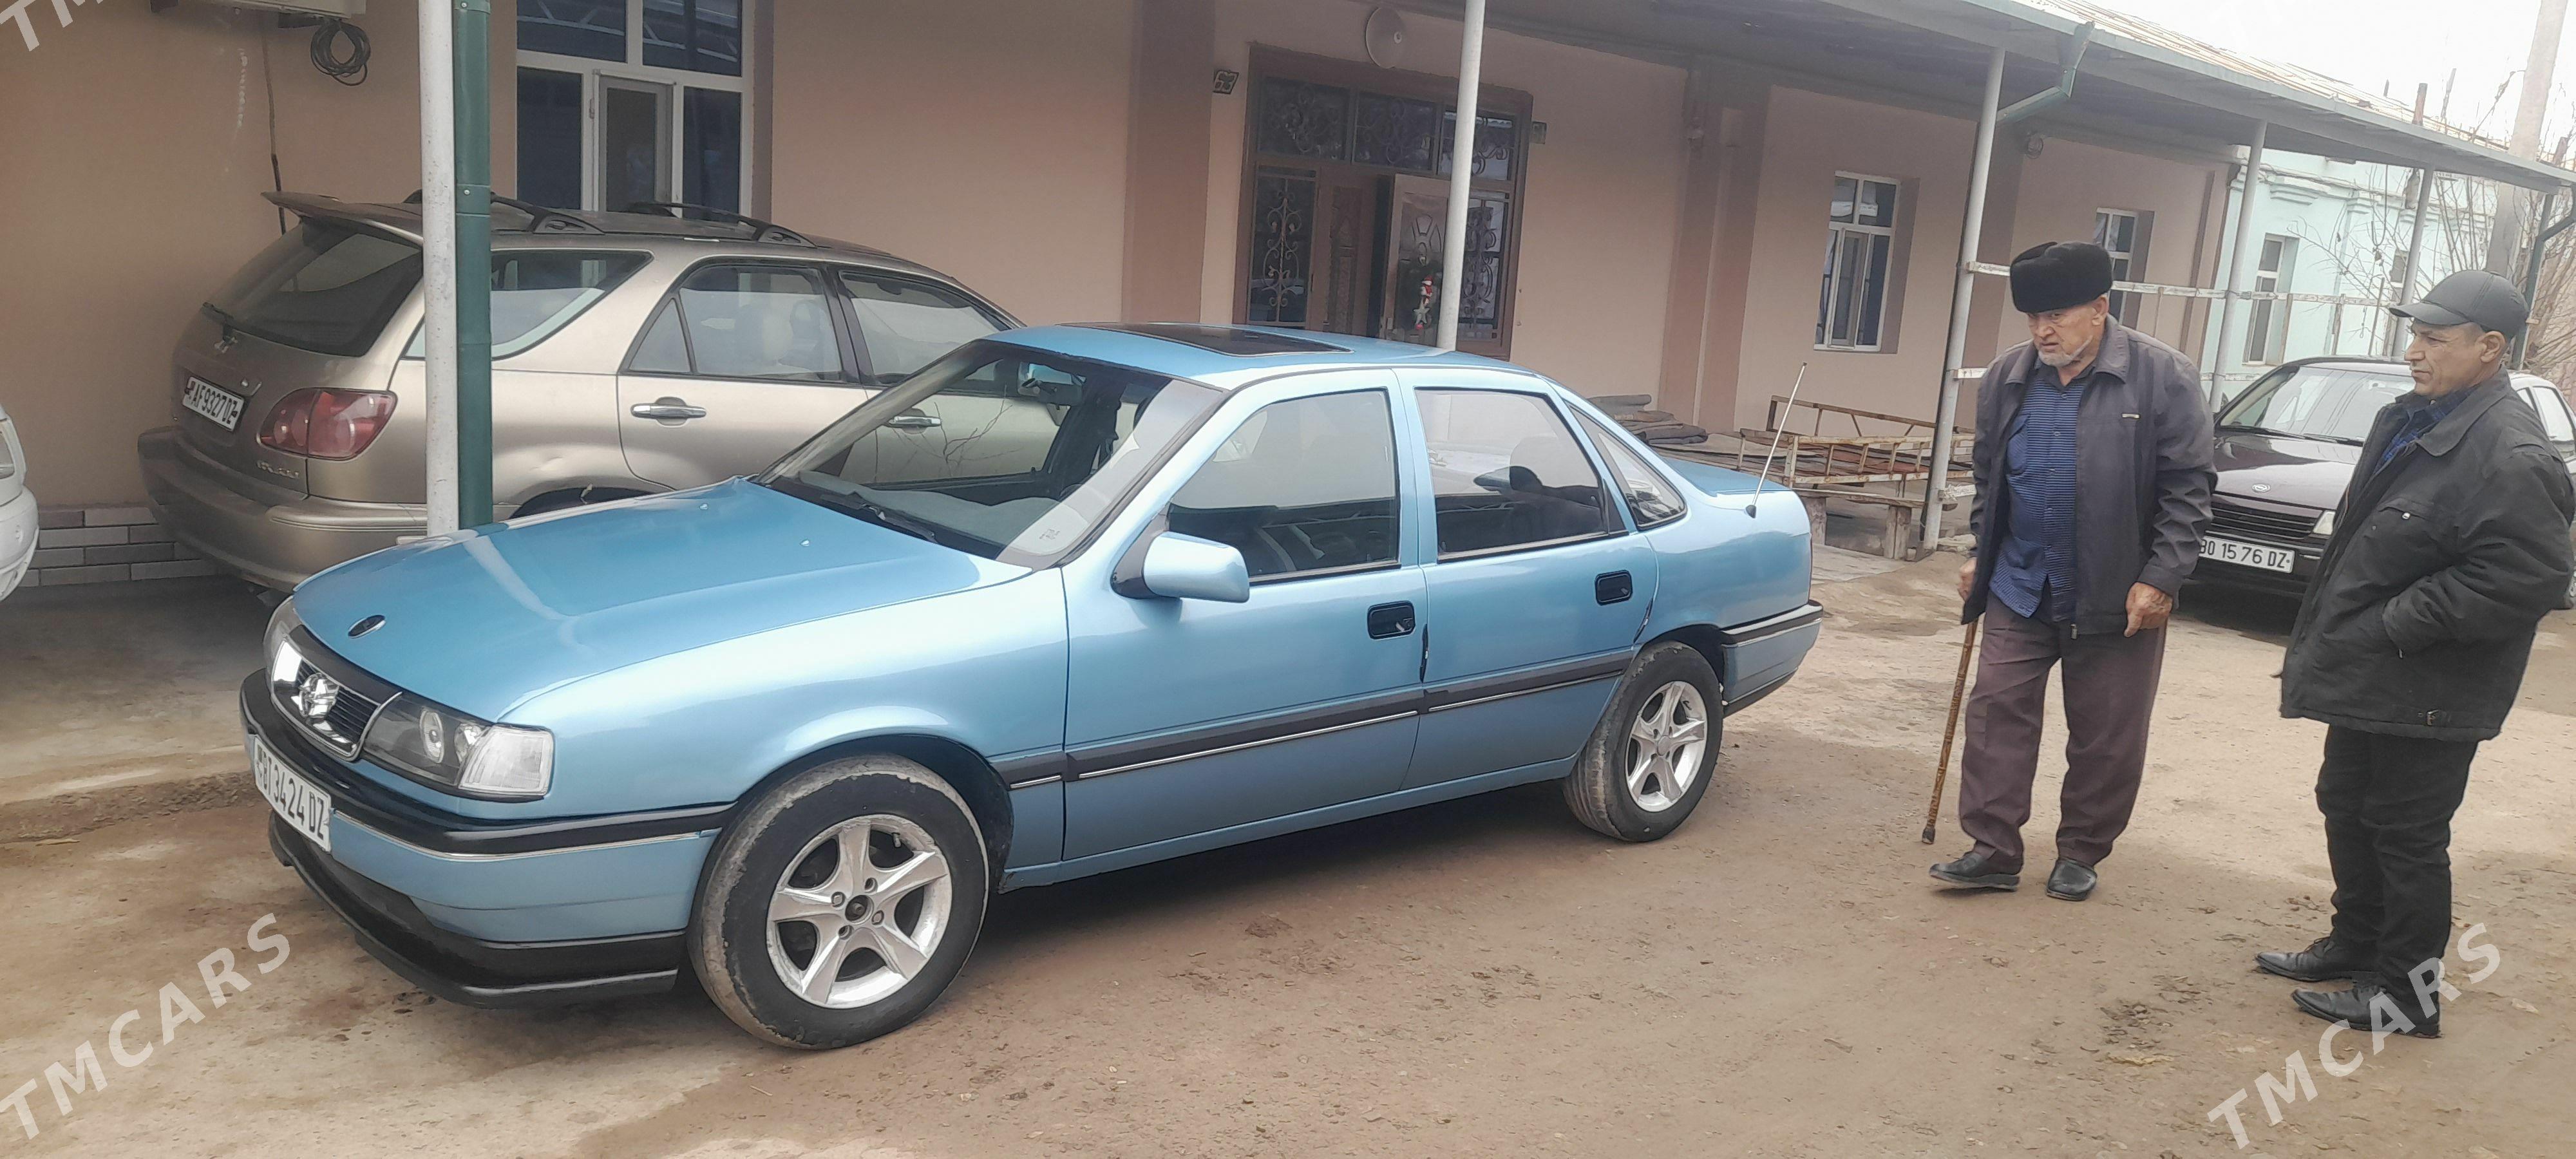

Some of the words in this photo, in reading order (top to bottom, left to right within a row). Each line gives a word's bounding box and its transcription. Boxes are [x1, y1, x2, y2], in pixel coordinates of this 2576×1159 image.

[2222, 543, 2237, 560] 15
[2240, 546, 2264, 564] 76
[2267, 551, 2288, 569] DZ
[273, 764, 305, 826] 3424
[308, 791, 325, 841] DZ
